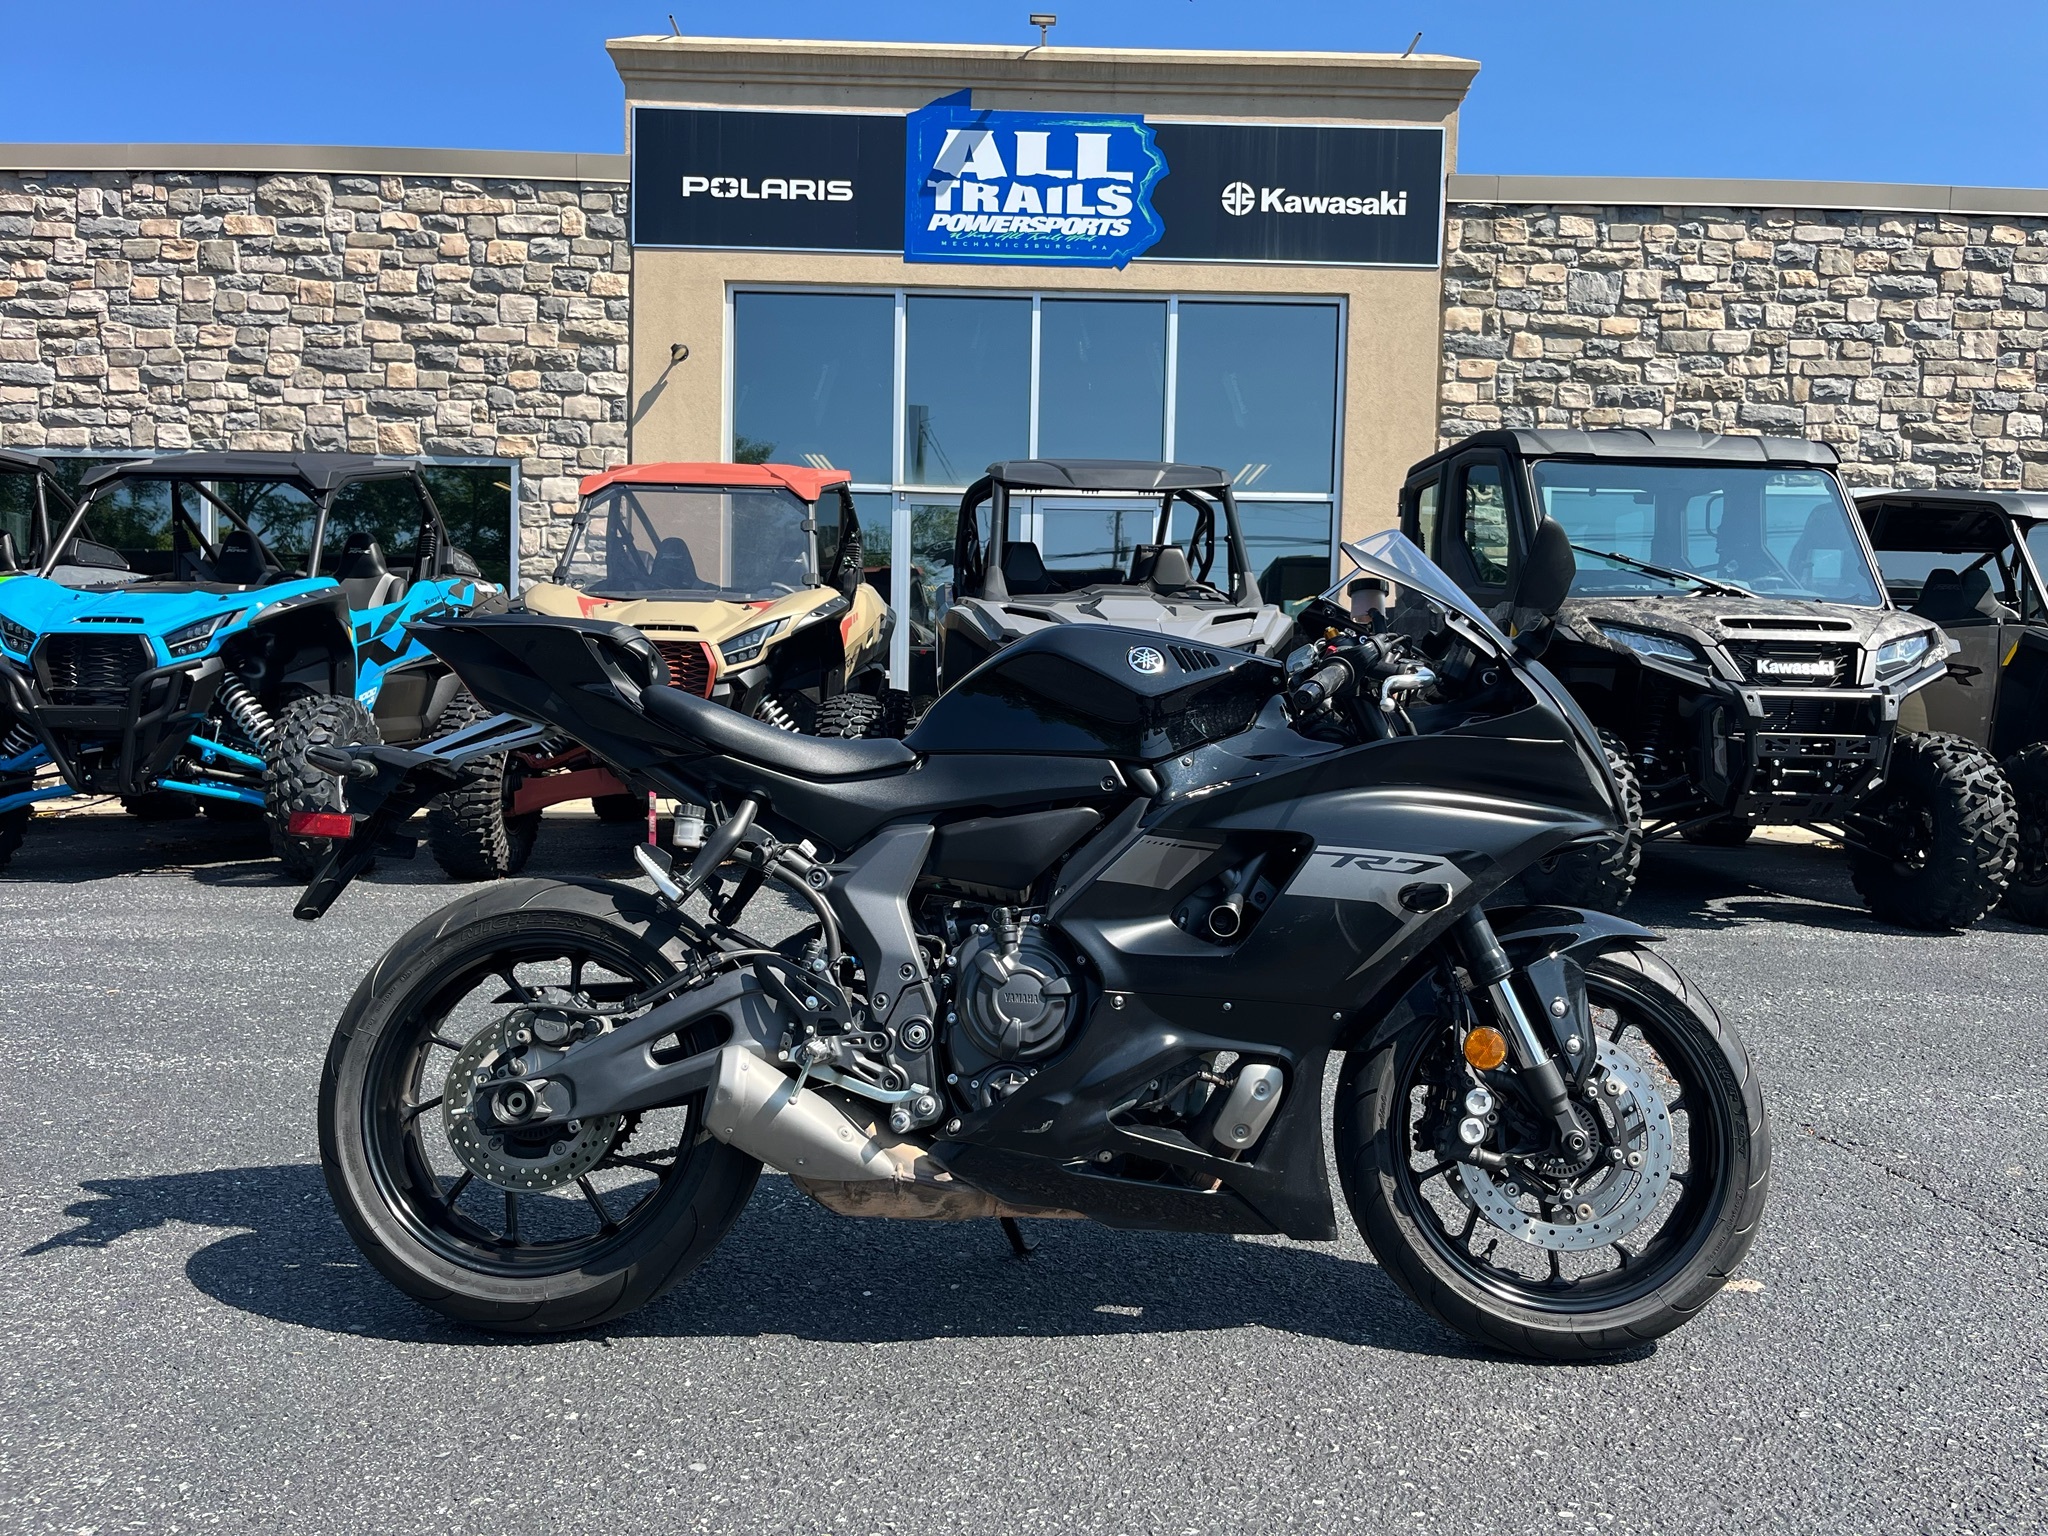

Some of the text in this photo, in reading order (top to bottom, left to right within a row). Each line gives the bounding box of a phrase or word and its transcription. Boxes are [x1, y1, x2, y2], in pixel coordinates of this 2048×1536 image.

[933, 129, 1134, 184] ALL
[682, 176, 854, 201] POLARIS
[927, 179, 1134, 216] TRAILS
[1260, 187, 1408, 216] Kawasaki
[927, 213, 1132, 237] POWERSPORTS
[1756, 659, 1835, 676] Kawasaki
[1004, 992, 1039, 1005] YAMAHA
